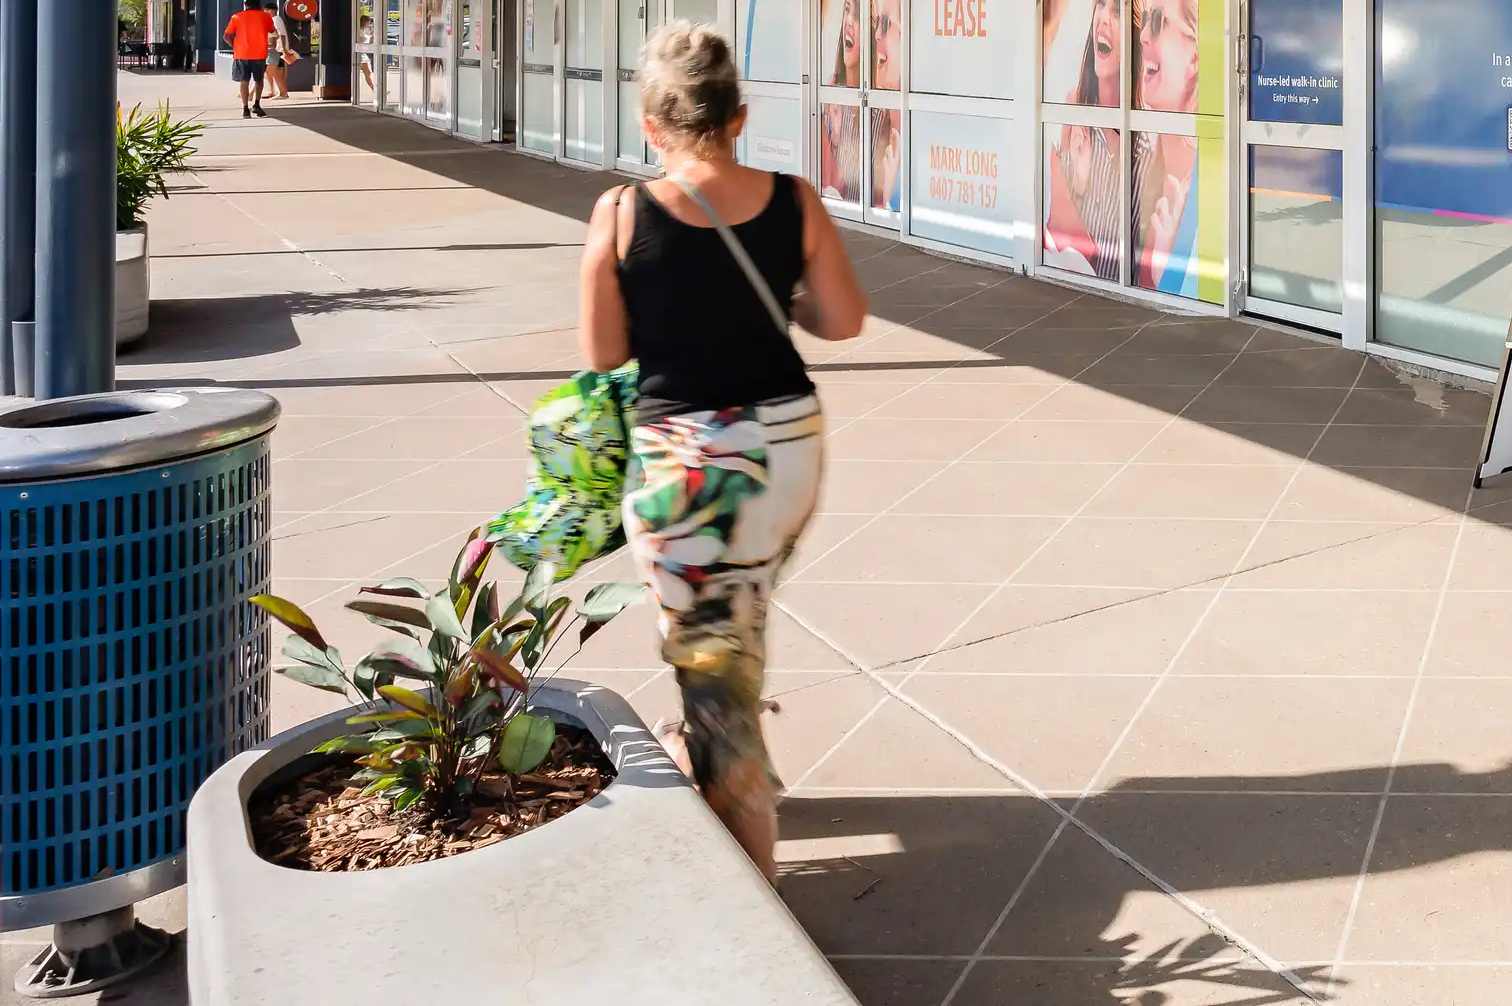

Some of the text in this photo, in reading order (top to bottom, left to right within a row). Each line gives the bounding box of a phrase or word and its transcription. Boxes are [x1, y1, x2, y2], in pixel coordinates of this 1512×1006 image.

[1492, 52, 1502, 66] In
[1258, 74, 1338, 89] Nurse-led walk-in clinic
[1273, 93, 1310, 105] Entry this way
[930, 144, 998, 179] MARK LONG
[930, 176, 998, 210] 0407 781 157
